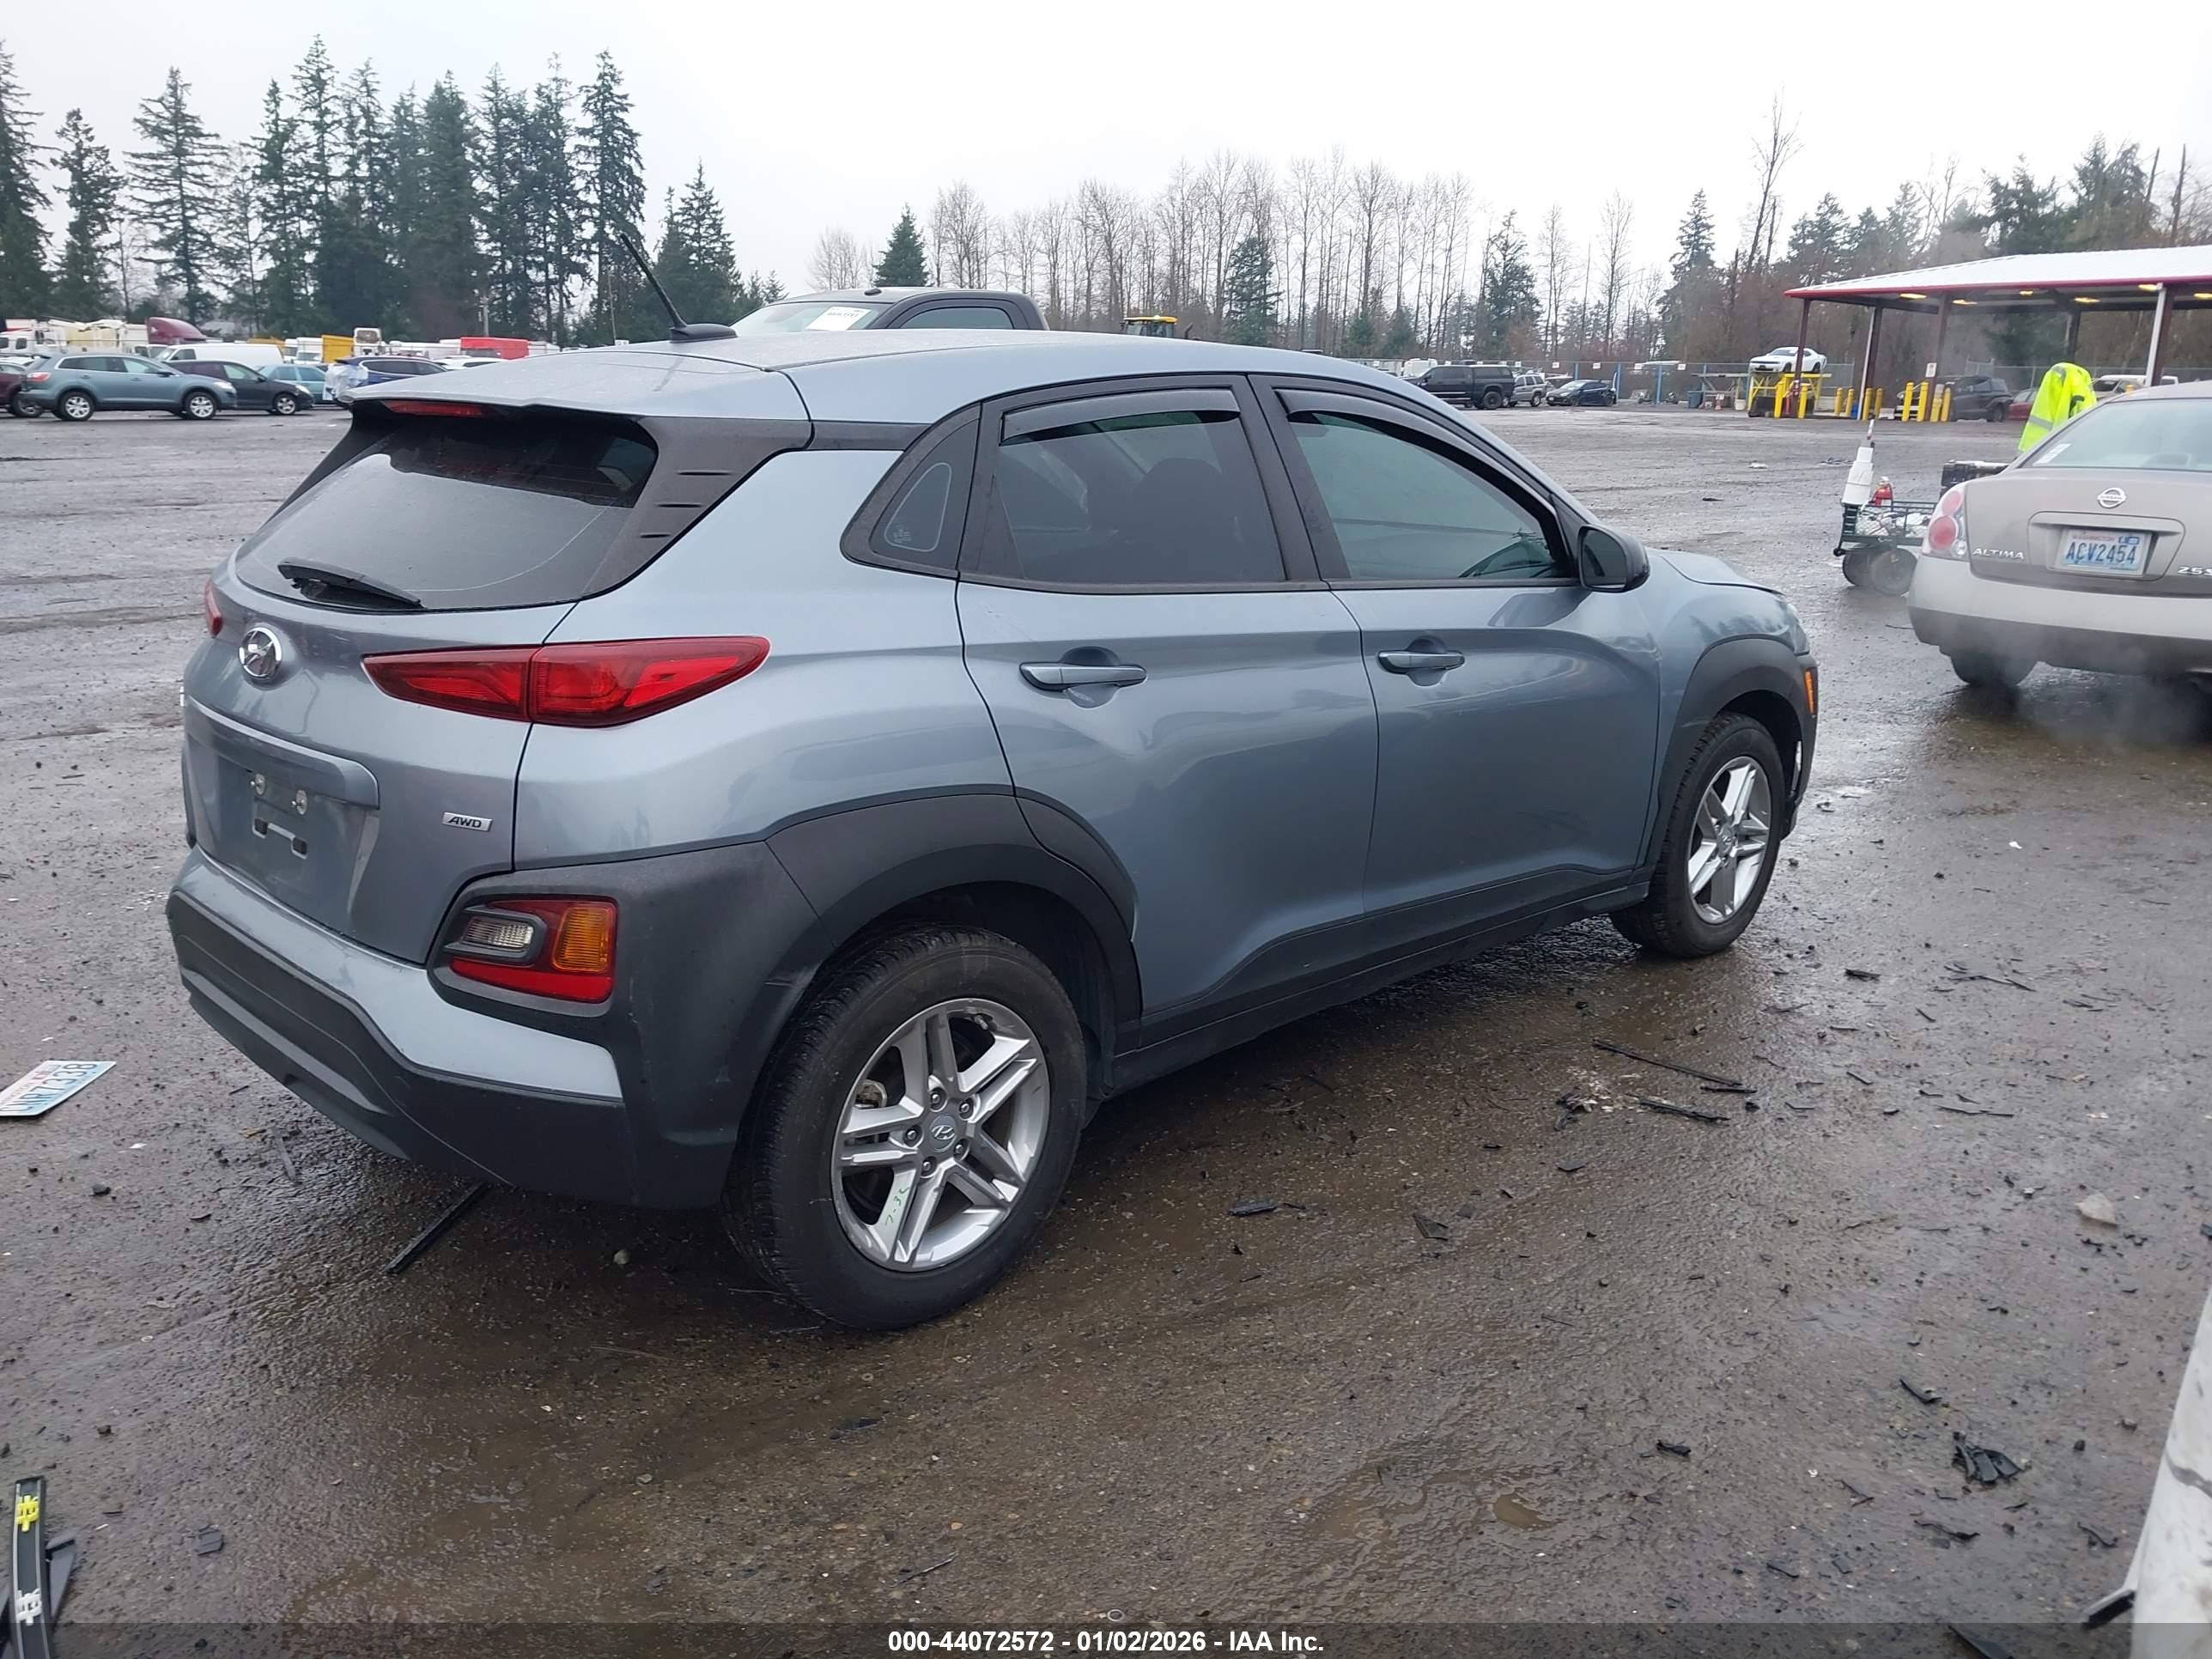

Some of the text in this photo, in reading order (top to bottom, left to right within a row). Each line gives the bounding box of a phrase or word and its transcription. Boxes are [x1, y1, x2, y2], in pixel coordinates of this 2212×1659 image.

[1972, 548, 2025, 560] ALTIMA
[2065, 541, 2137, 564] ACV2454
[447, 816, 482, 828] AWD
